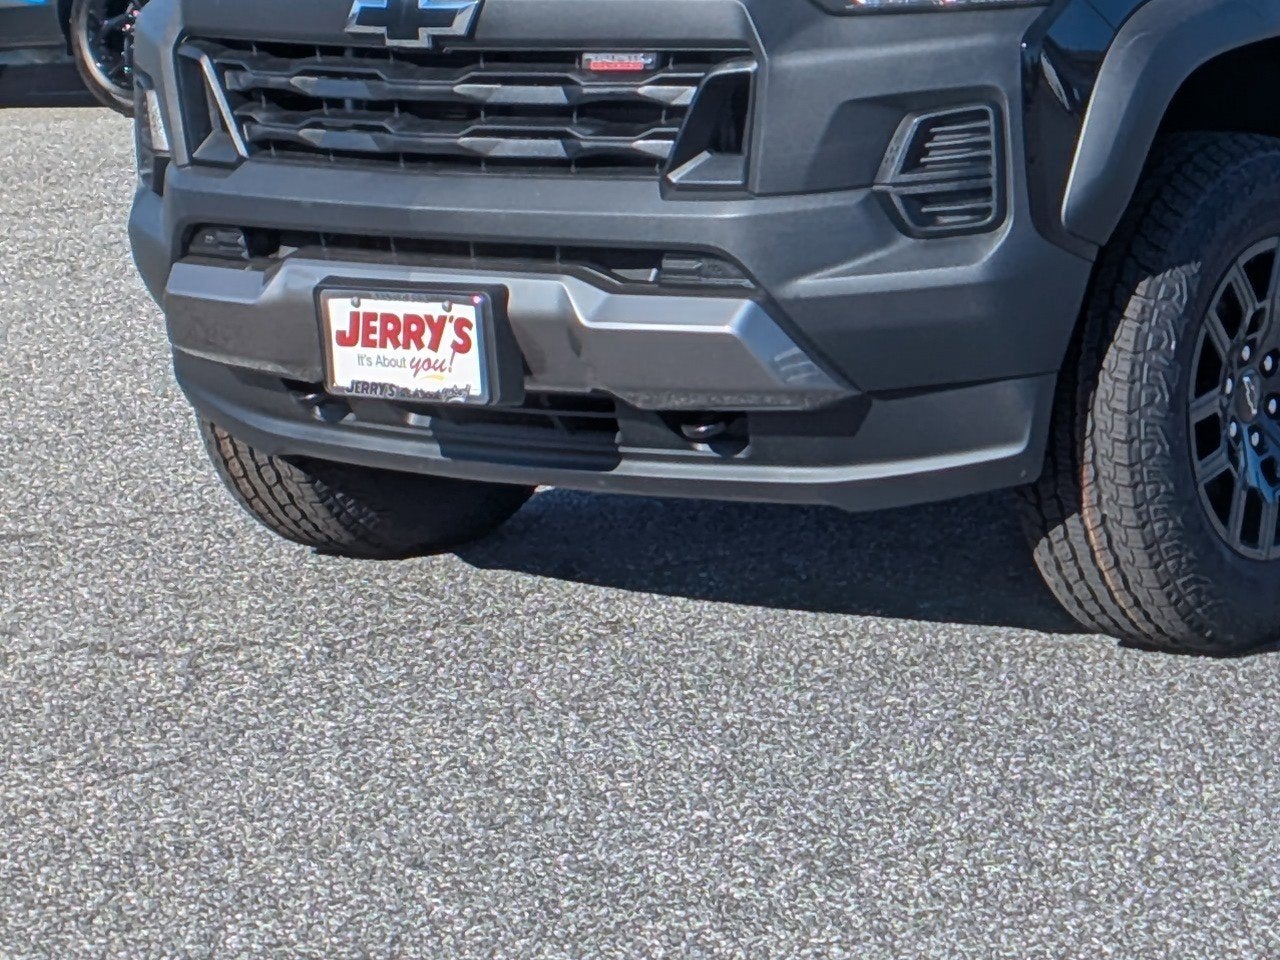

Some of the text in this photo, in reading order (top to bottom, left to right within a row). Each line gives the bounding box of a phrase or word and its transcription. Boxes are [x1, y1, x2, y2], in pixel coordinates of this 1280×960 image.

[335, 310, 474, 354] JERRY'S
[357, 350, 456, 378] It's About you!
